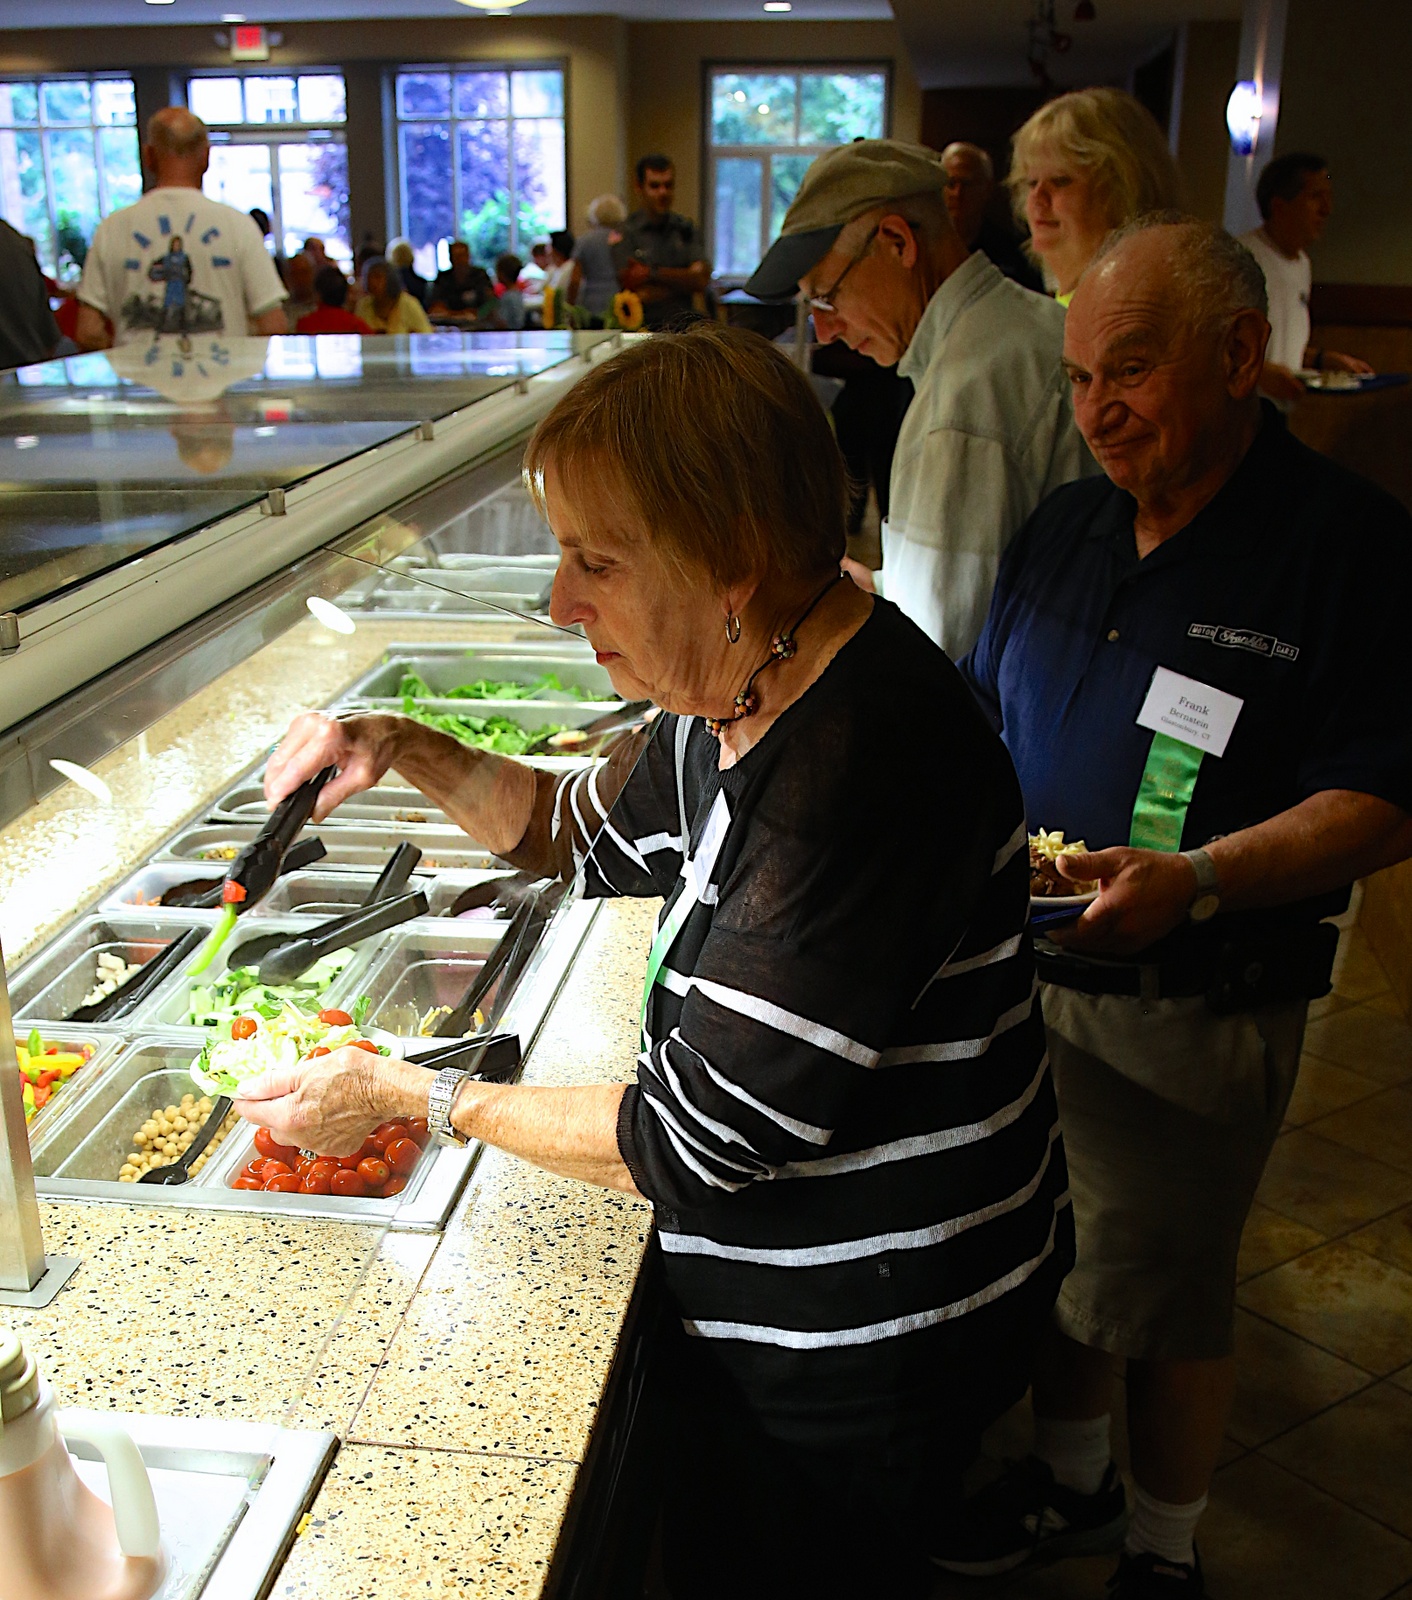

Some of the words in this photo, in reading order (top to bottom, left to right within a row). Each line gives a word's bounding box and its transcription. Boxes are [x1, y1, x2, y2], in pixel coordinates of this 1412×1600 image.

[1191, 625, 1216, 637] MOTOR
[1219, 629, 1269, 652] Franklin
[1275, 645, 1296, 657] CARS
[1178, 695, 1210, 716] Frank
[1169, 707, 1209, 729] Bernstein
[1201, 732, 1211, 740] CT
